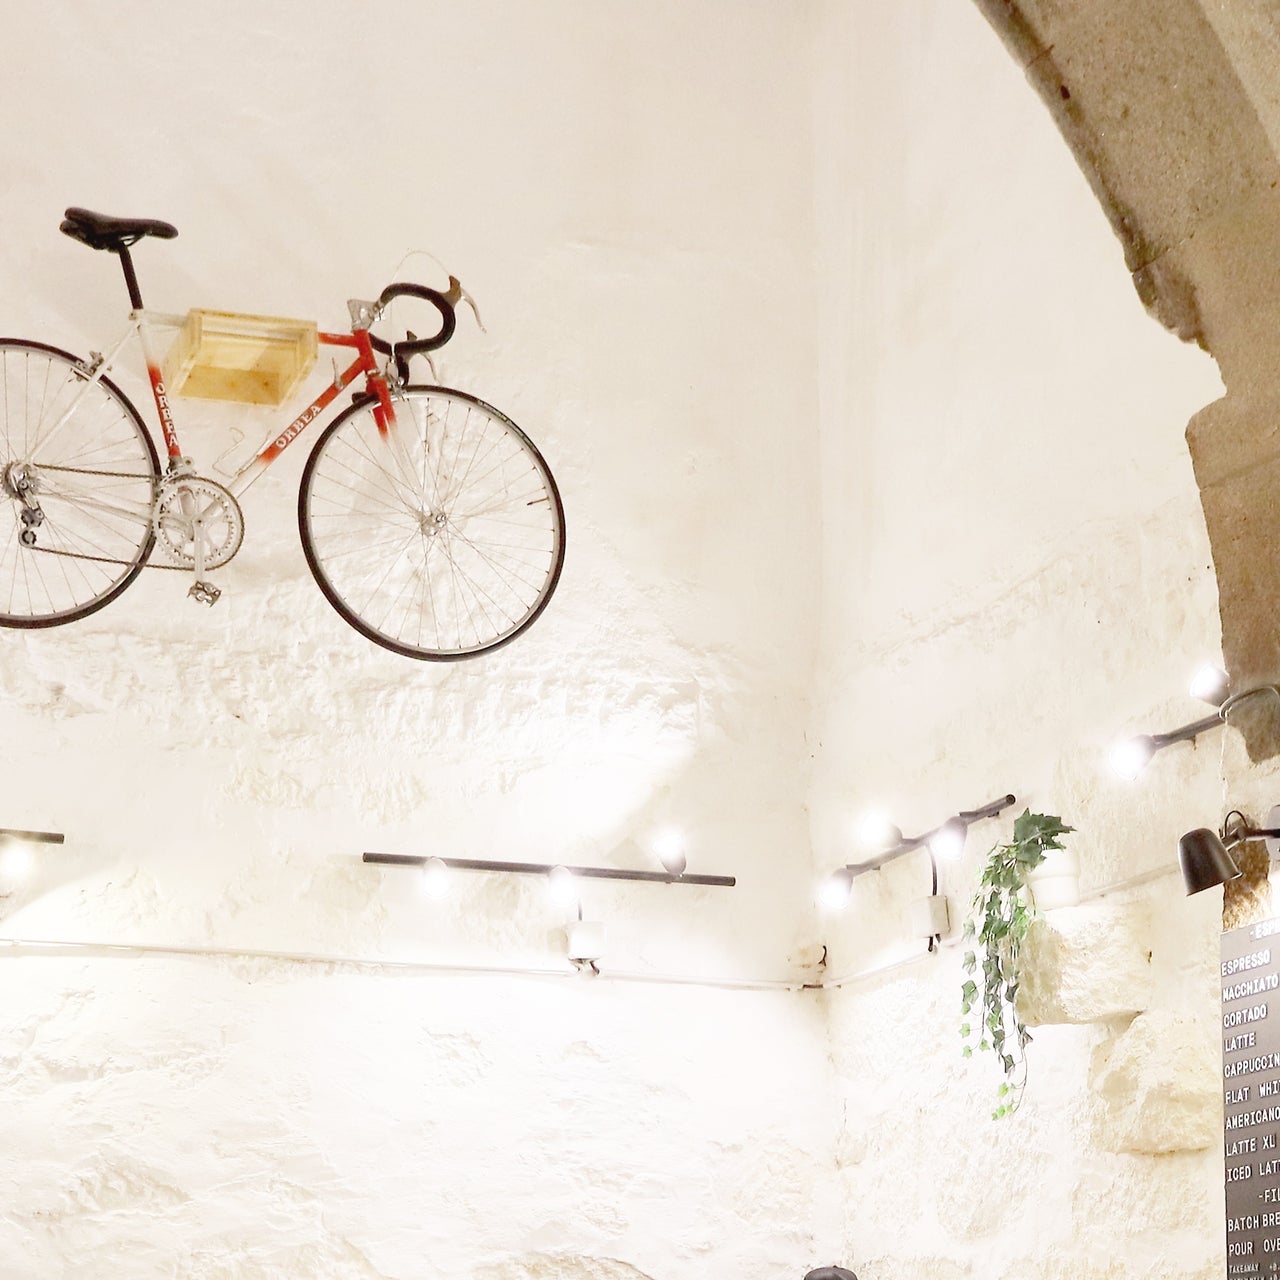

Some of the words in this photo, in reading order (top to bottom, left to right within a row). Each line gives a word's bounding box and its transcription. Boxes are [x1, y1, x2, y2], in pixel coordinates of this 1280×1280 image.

[275, 404, 321, 449] ORBEA
[1221, 949, 1271, 977] ESPRESSO
[1223, 974, 1280, 1003] MACCHIATO
[1223, 1004, 1268, 1028] CORTADO
[1225, 1033, 1256, 1052] LATTE
[1225, 1087, 1250, 1105] FLAT
[1226, 1138, 1257, 1157] LATTE
[1263, 1134, 1276, 1149] XL
[1227, 1165, 1252, 1182] ICED
[1228, 1215, 1259, 1232] BATCH
[1228, 1241, 1253, 1257] POUR
[1229, 1263, 1259, 1273] TAKEAWAY
